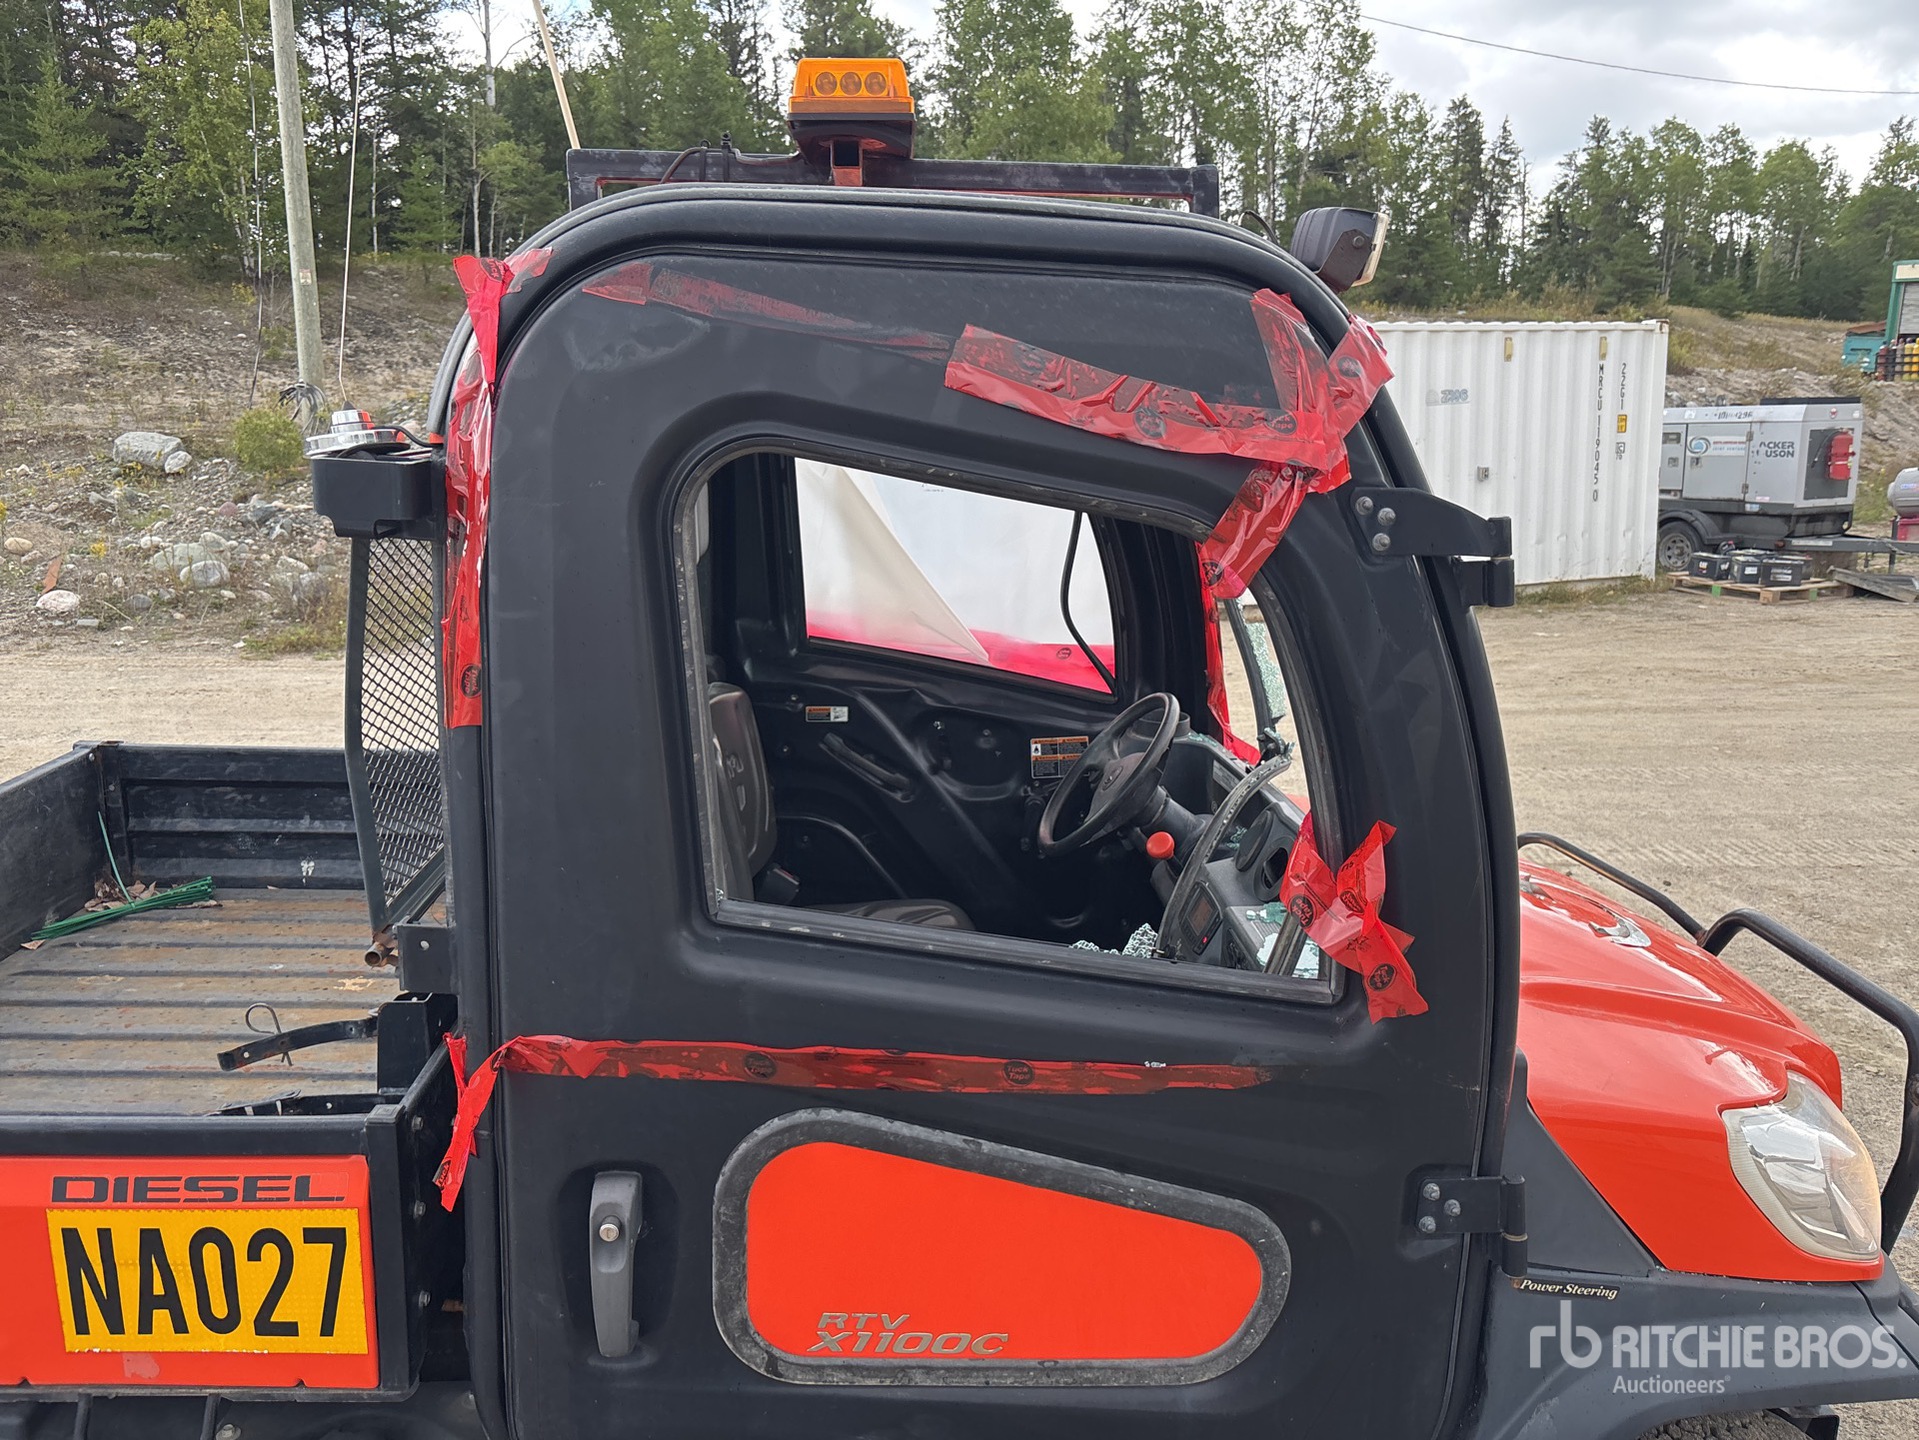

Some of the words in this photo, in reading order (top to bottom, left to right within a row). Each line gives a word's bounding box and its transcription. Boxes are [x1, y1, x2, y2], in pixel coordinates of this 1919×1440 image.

[1597, 363, 1605, 411] MRCU
[1291, 904, 1310, 926] Tuck
[1295, 898, 1313, 919] Tape
[1006, 1065, 1029, 1073] Tuck
[1009, 1072, 1031, 1081] Tape
[51, 1175, 346, 1203] DIESEL
[61, 1226, 347, 1337] NA027
[1520, 1279, 1563, 1293] Power
[1563, 1283, 1618, 1300] Steering
[817, 1312, 910, 1330] RTV
[807, 1331, 1009, 1355] X1100C
